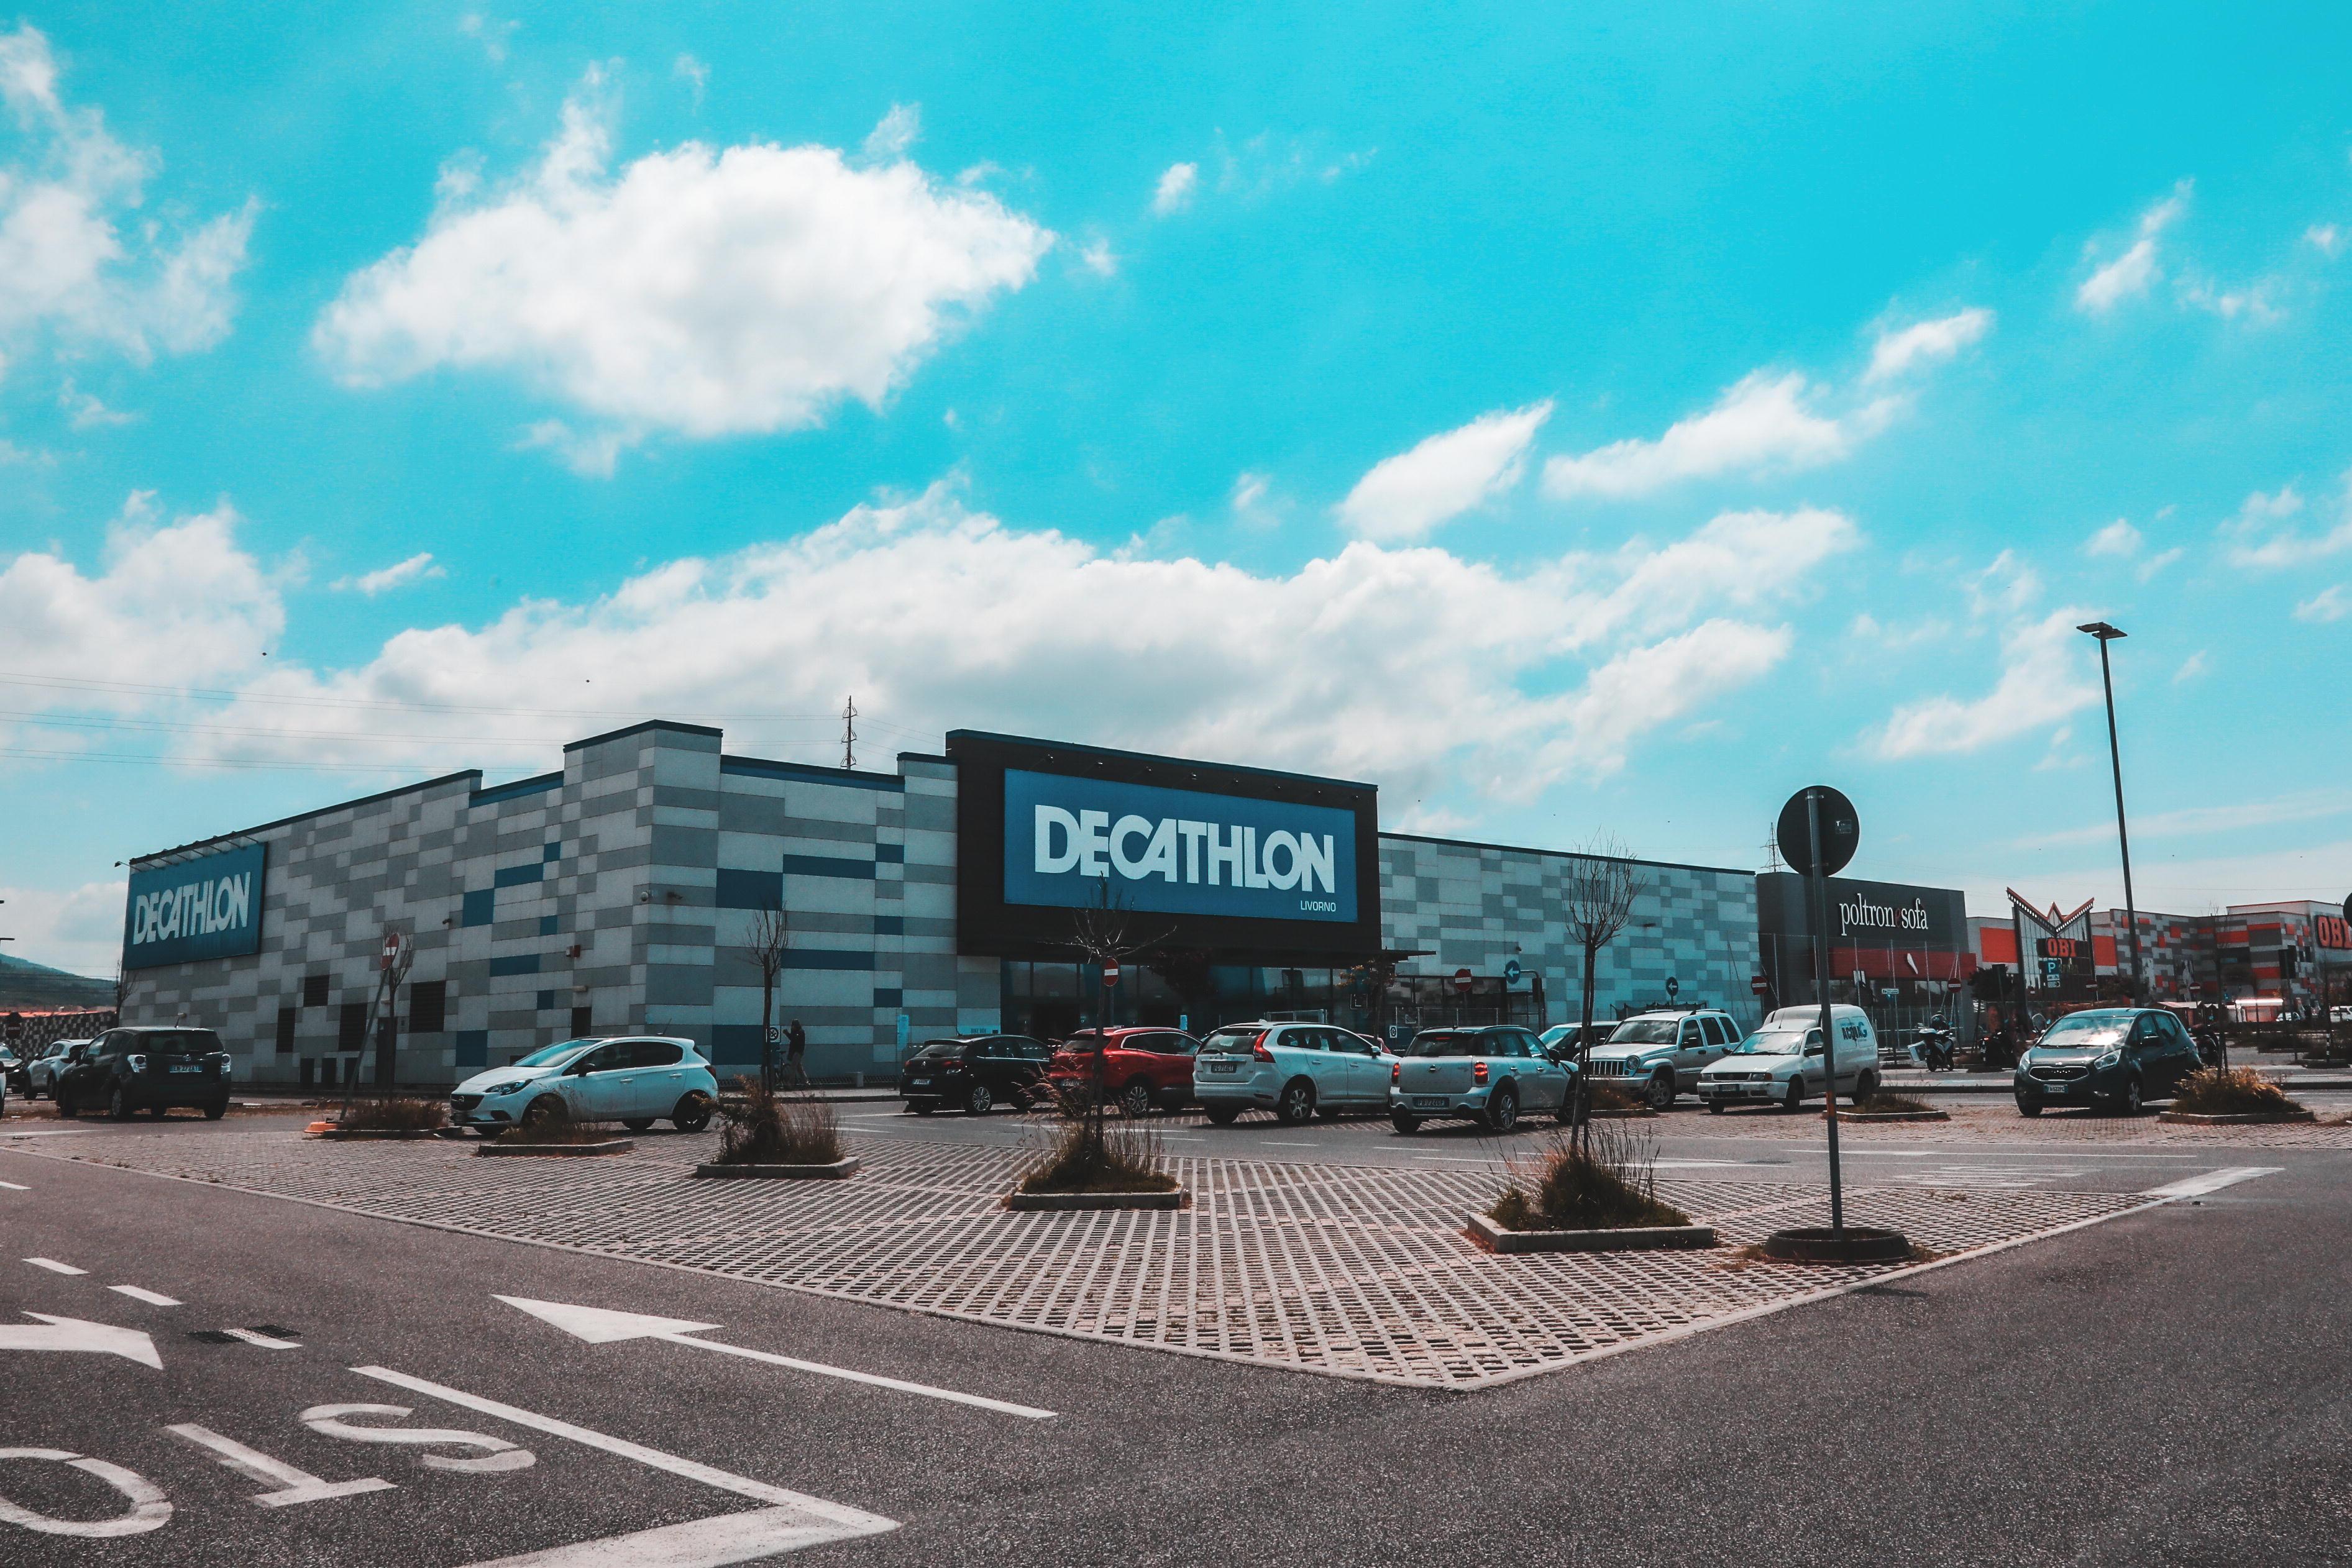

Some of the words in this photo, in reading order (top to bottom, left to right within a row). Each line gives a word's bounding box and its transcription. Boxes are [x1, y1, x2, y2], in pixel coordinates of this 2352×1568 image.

[1035, 804, 1335, 893] DECATHLON
[133, 872, 250, 945] DECATHLON
[1300, 900, 1336, 912] LIVORNO
[2048, 937, 2077, 957] OBI
[2048, 962, 2056, 973] P
